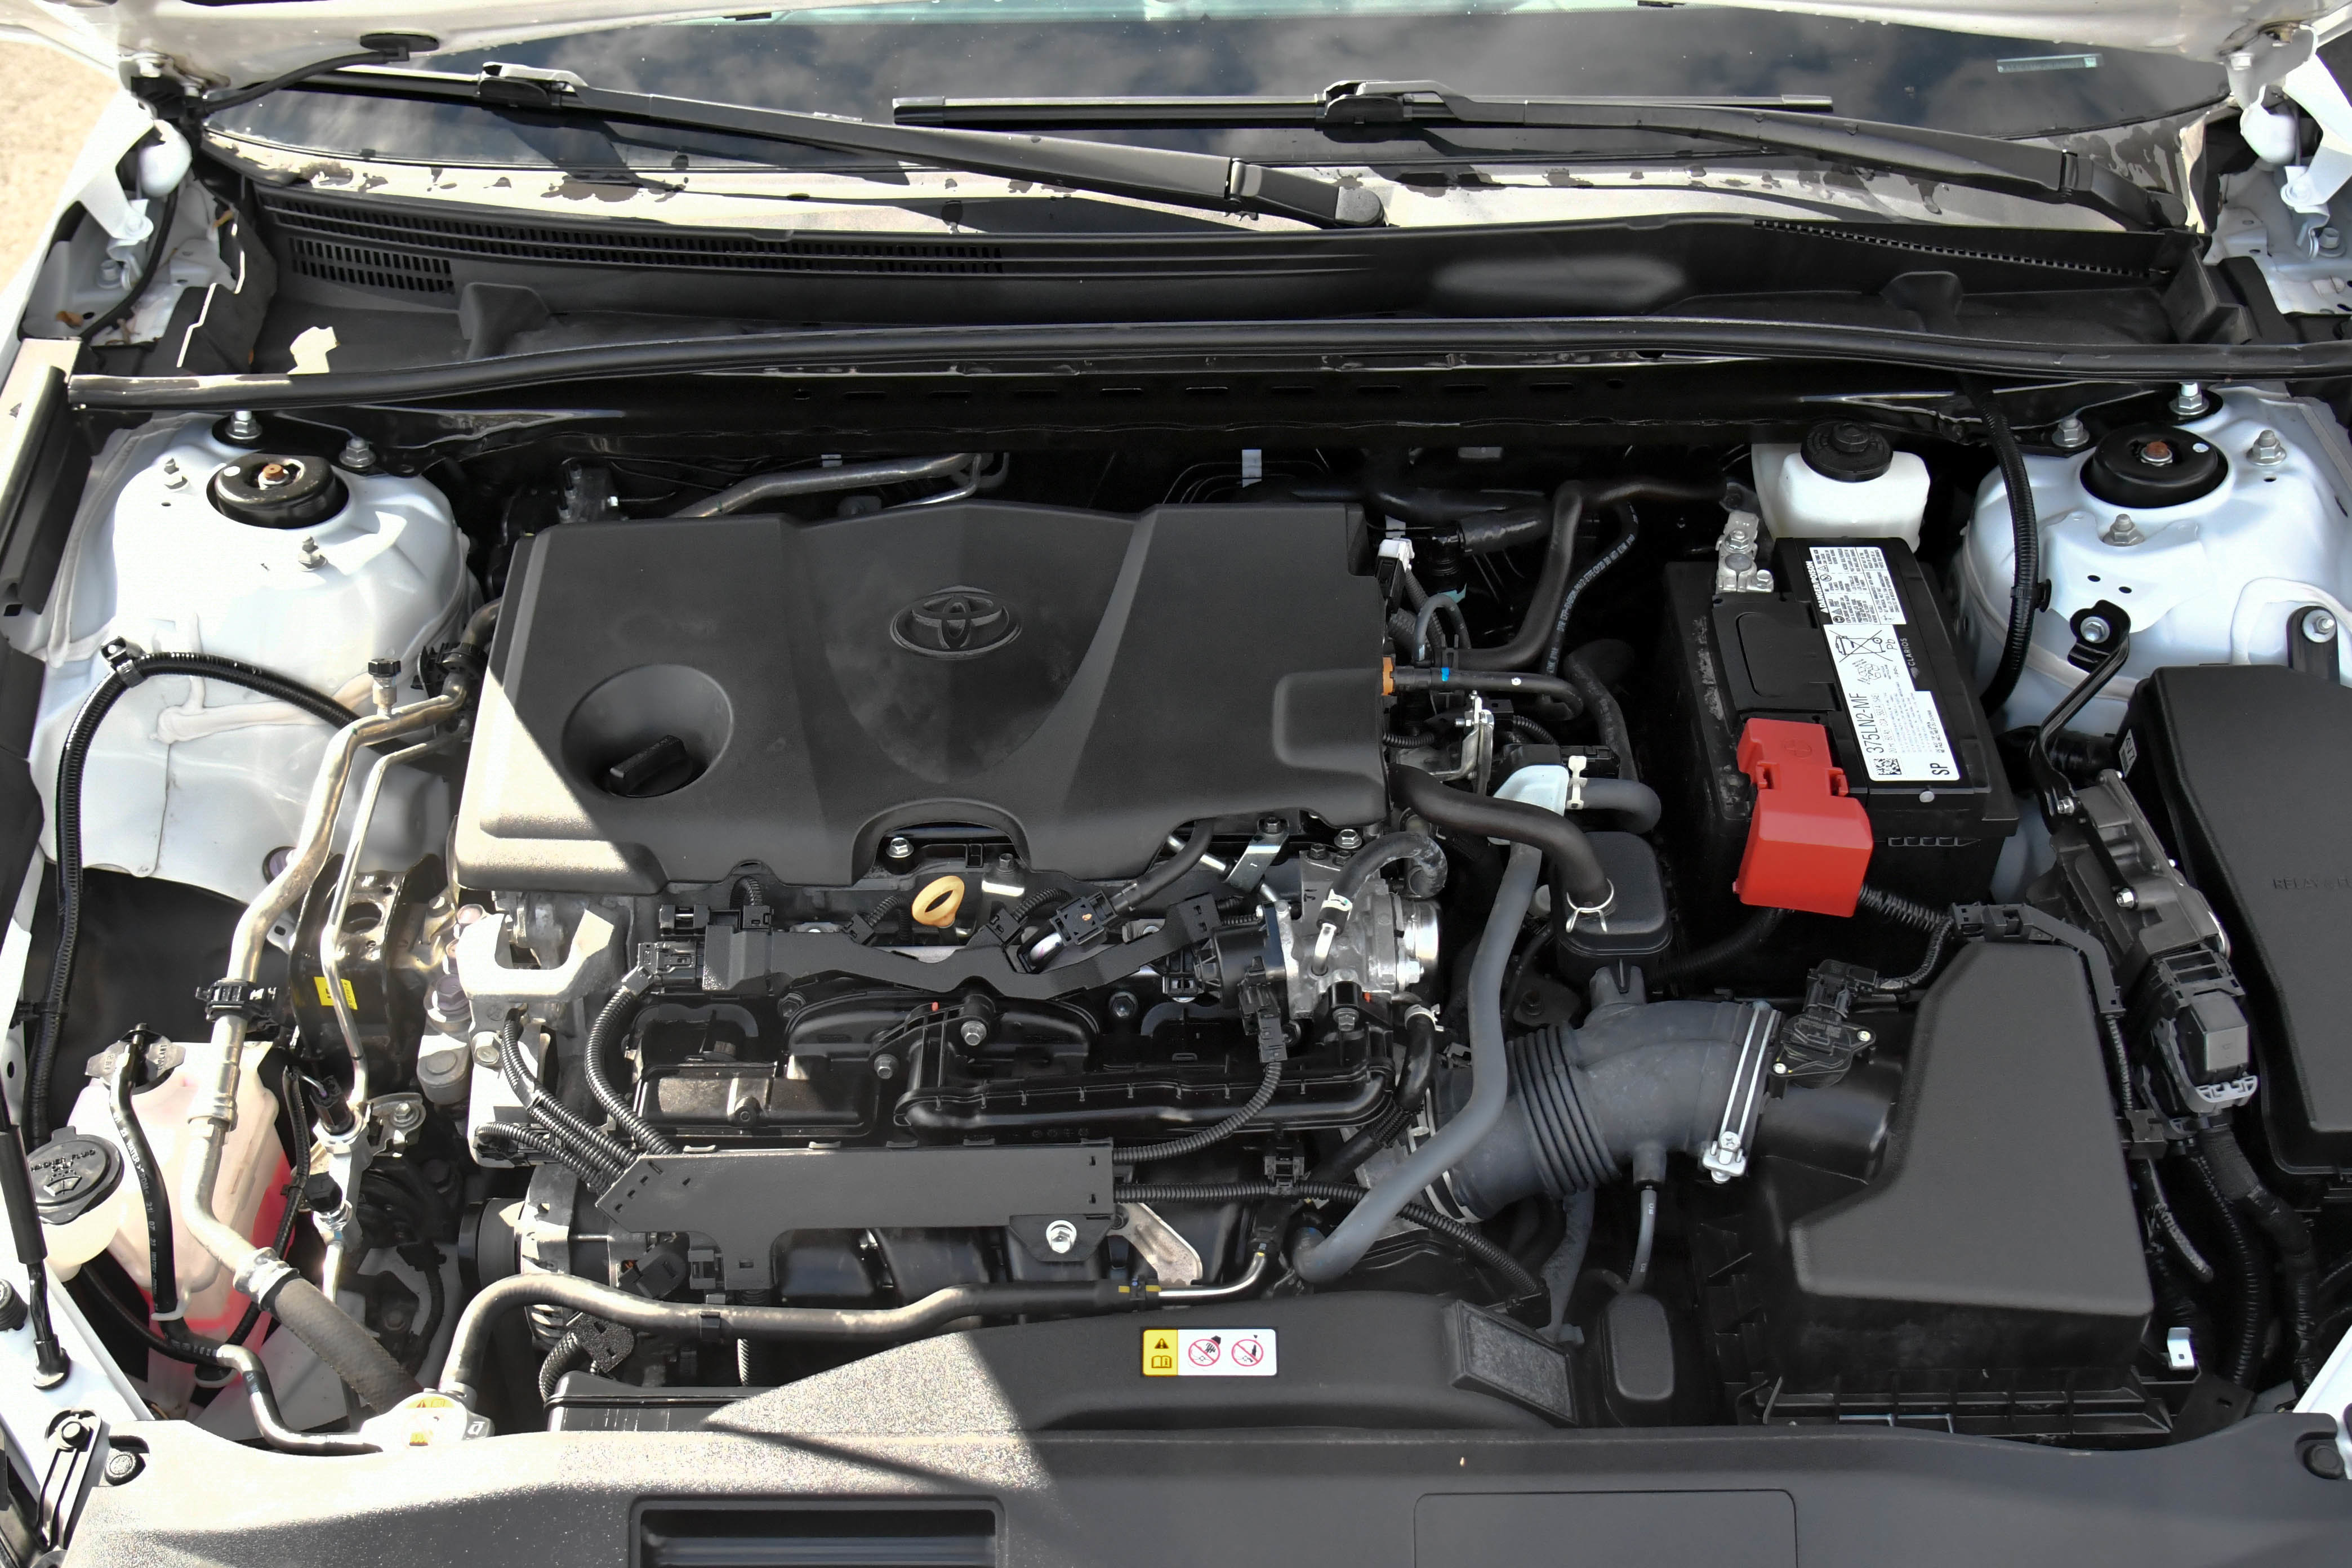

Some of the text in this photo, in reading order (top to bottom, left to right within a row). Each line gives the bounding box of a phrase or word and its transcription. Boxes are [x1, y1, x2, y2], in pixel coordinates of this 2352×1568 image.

[1806, 560, 1828, 608] DANGER/POISON
[1883, 638, 1897, 650] Pb
[1899, 637, 1916, 666] CLARIOS
[1848, 693, 1885, 752] 375LN2-MF
[1928, 762, 1950, 775] SP
[158, 1045, 167, 1071] COOLANT
[72, 1149, 96, 1161] FLUID
[126, 1139, 140, 1165] WATER
[148, 1220, 155, 1231] 07
